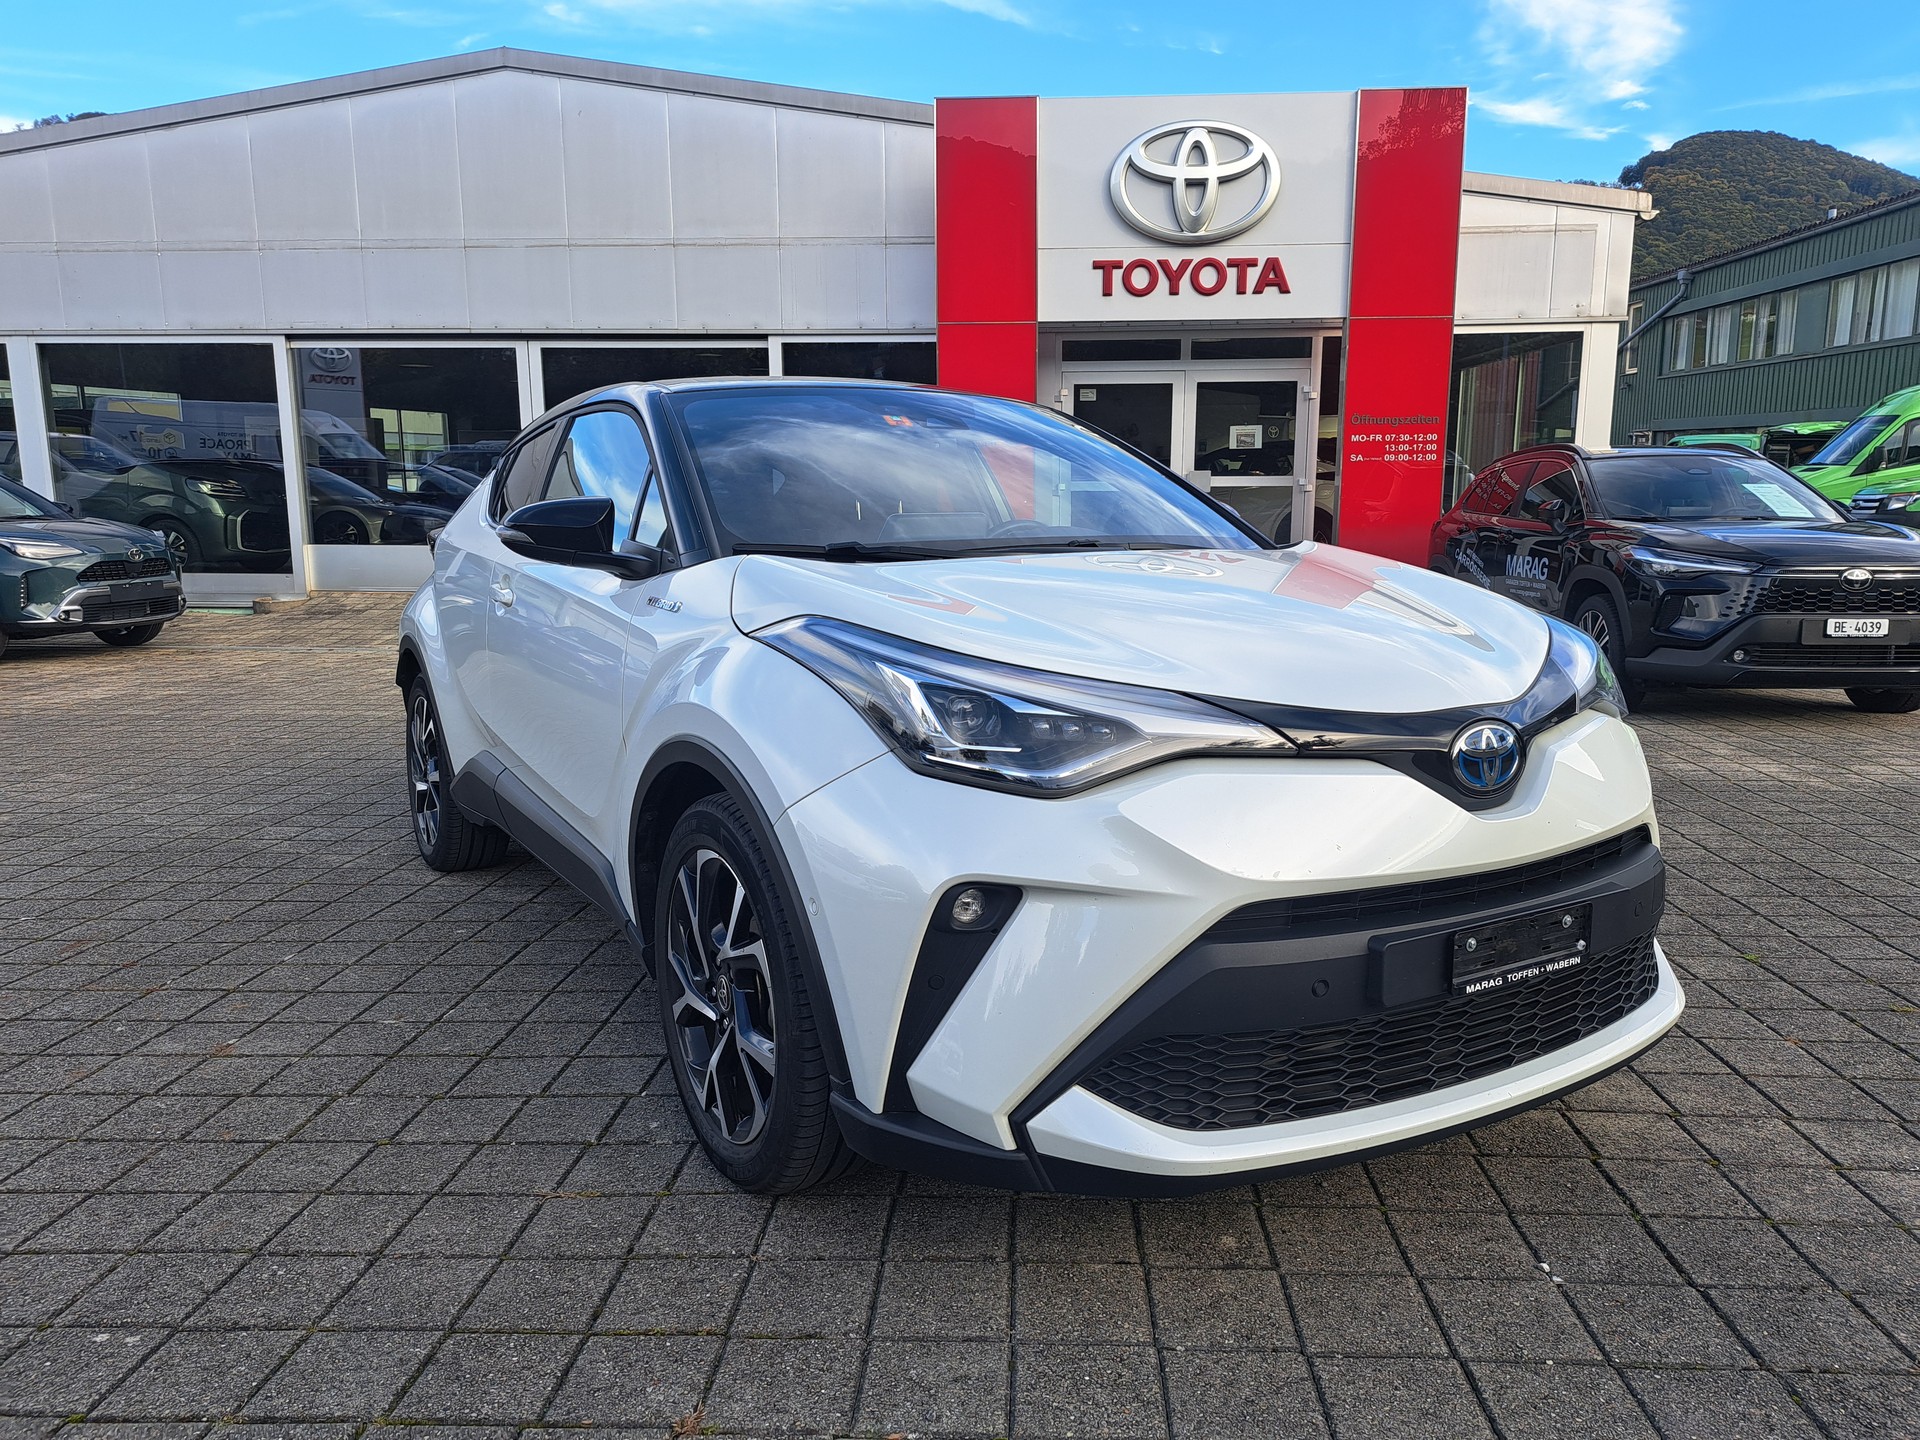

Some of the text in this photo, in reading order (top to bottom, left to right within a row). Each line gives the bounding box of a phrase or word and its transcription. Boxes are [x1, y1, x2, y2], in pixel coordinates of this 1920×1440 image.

[1093, 257, 1291, 297] TOYOTA
[1351, 412, 1440, 427] Öffnungszeiten
[1351, 433, 1438, 442] MO-FR 07:30-12:00
[1350, 454, 1364, 462] SA
[1384, 453, 1437, 461] 09:00-12:00
[1506, 554, 1549, 580] MARAG
[1466, 977, 1503, 994] MARAG
[1507, 967, 1539, 982] TOFFEN
[1546, 957, 1581, 972] WABERN
